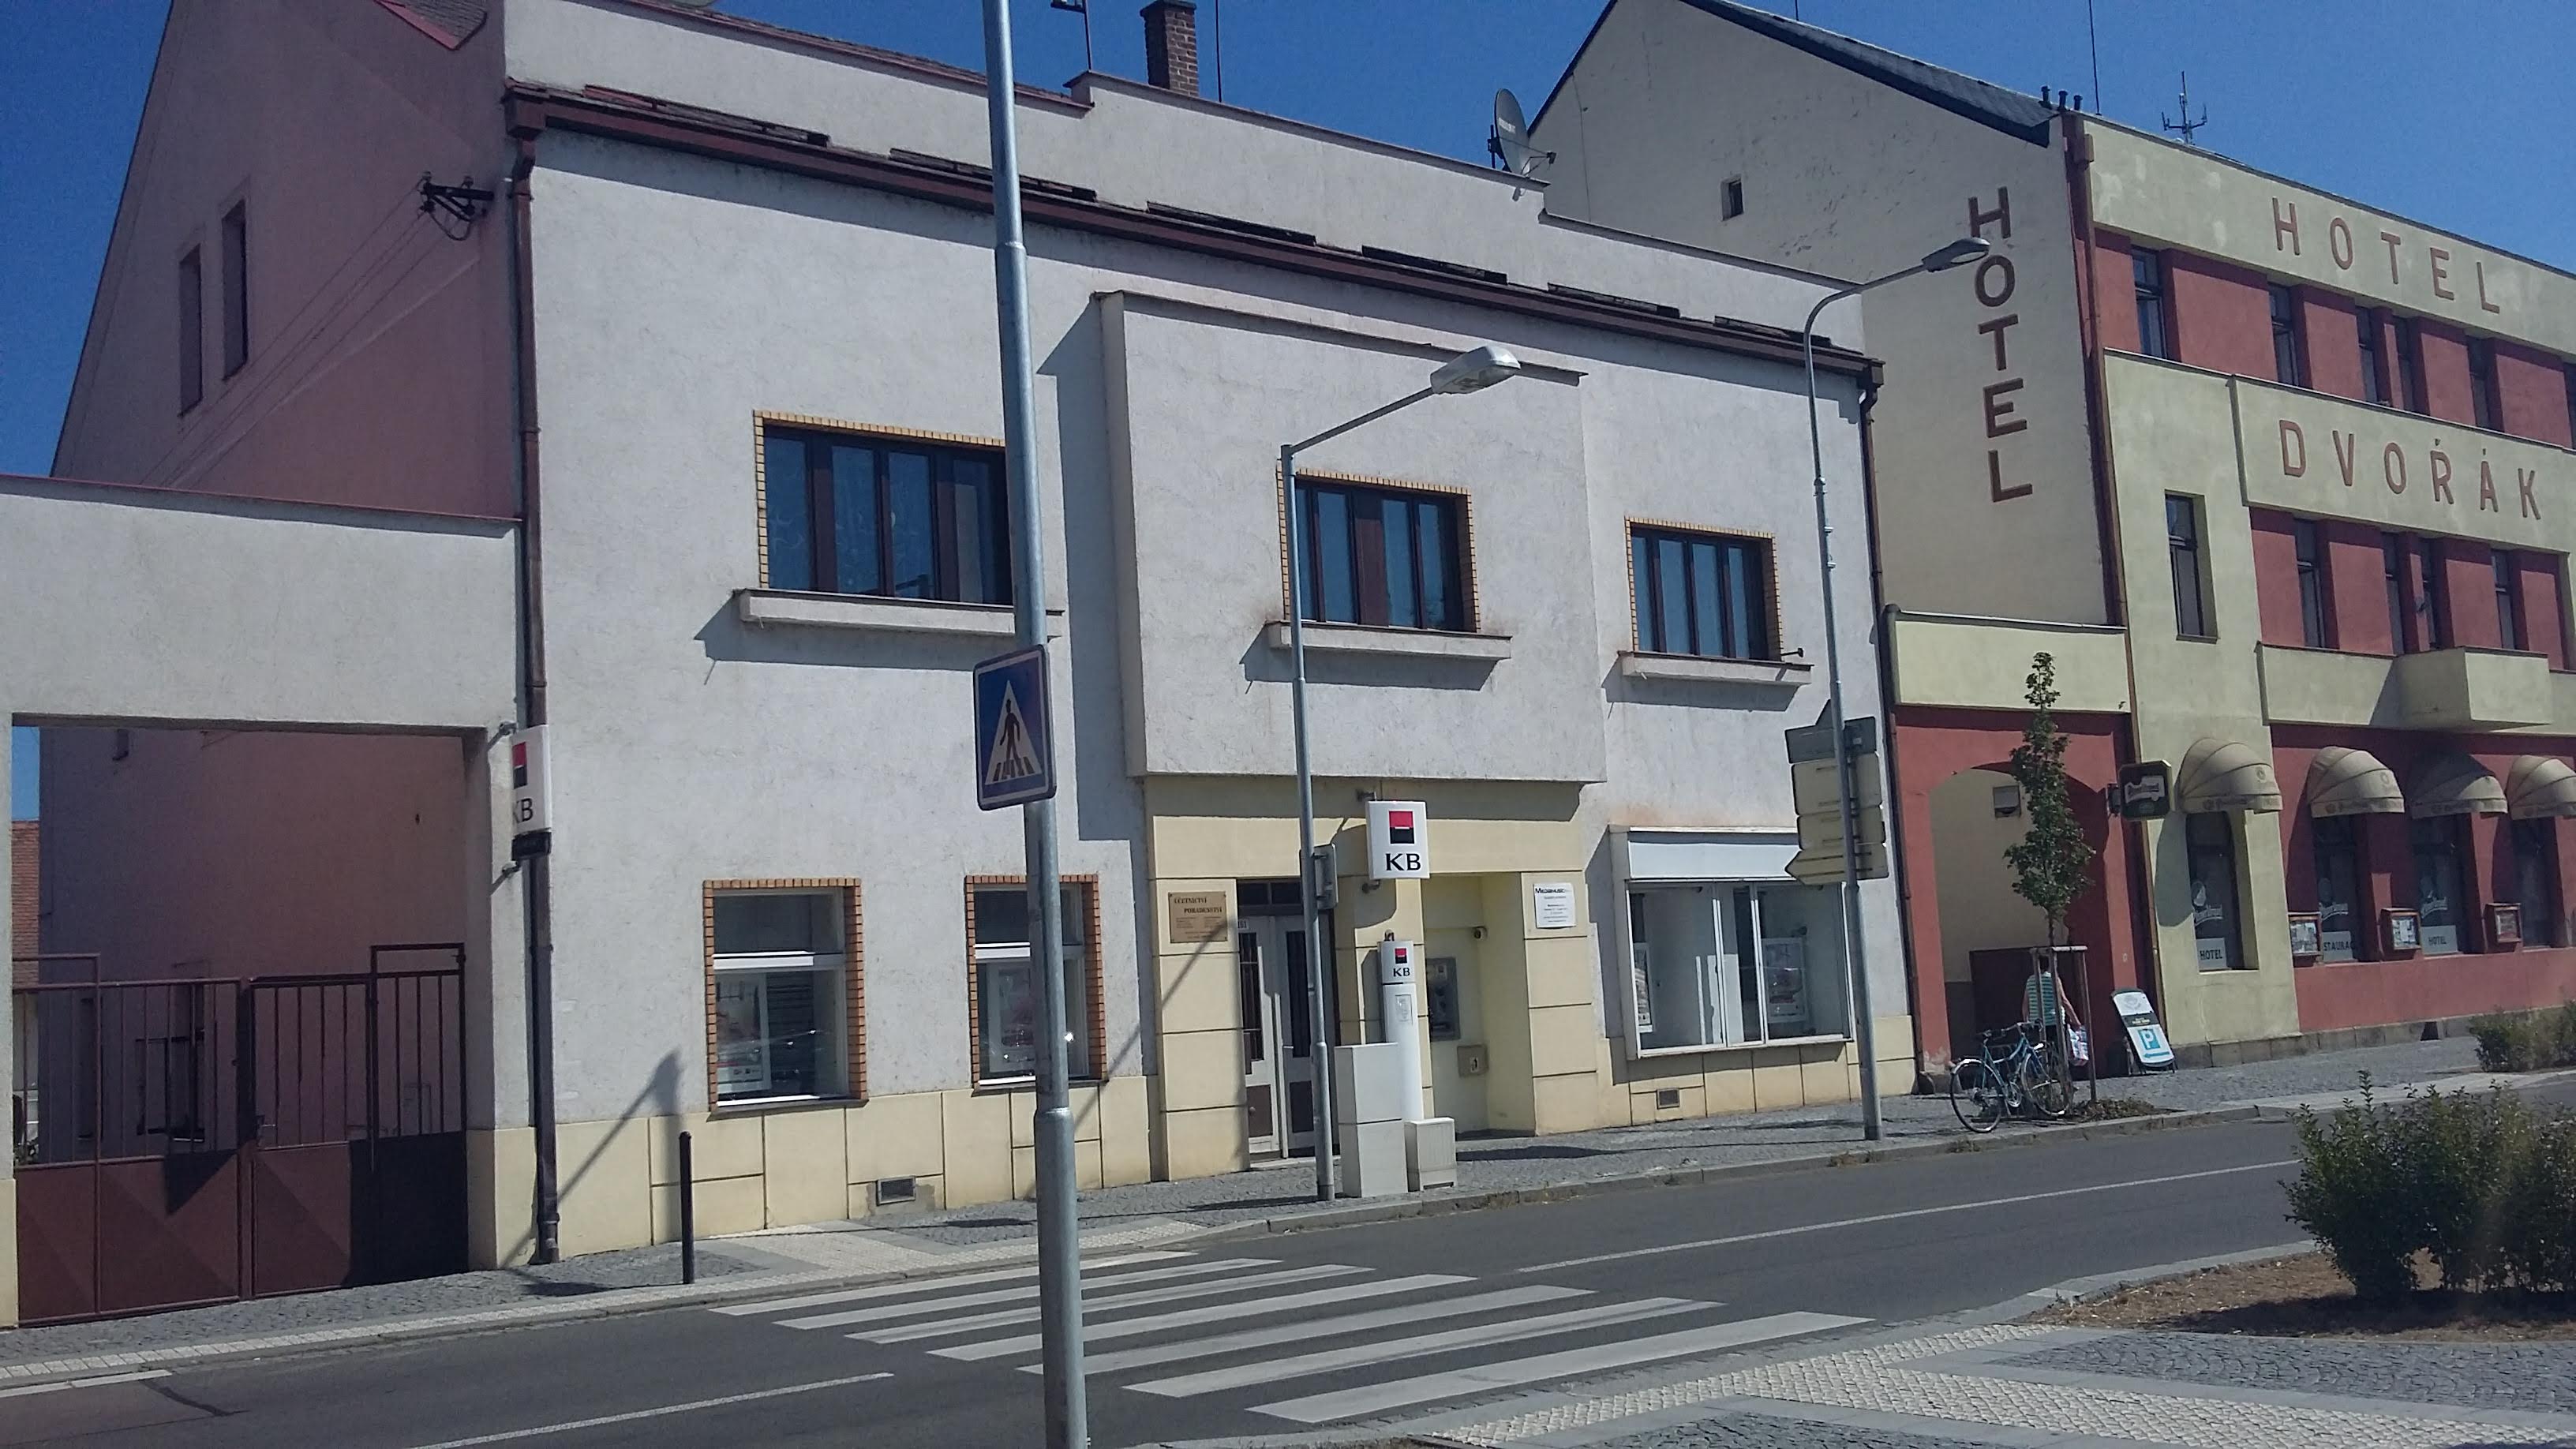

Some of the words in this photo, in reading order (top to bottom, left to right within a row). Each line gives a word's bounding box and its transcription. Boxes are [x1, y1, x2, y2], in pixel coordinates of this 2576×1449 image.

[2272, 197, 2500, 314] HOTEL
[1968, 186, 2033, 502] HOTEL
[2279, 418, 2542, 520] DVOŘÁK
[1385, 853, 1421, 871] KB
[1393, 968, 1411, 977] KB
[2200, 949, 2223, 960] HOTEL
